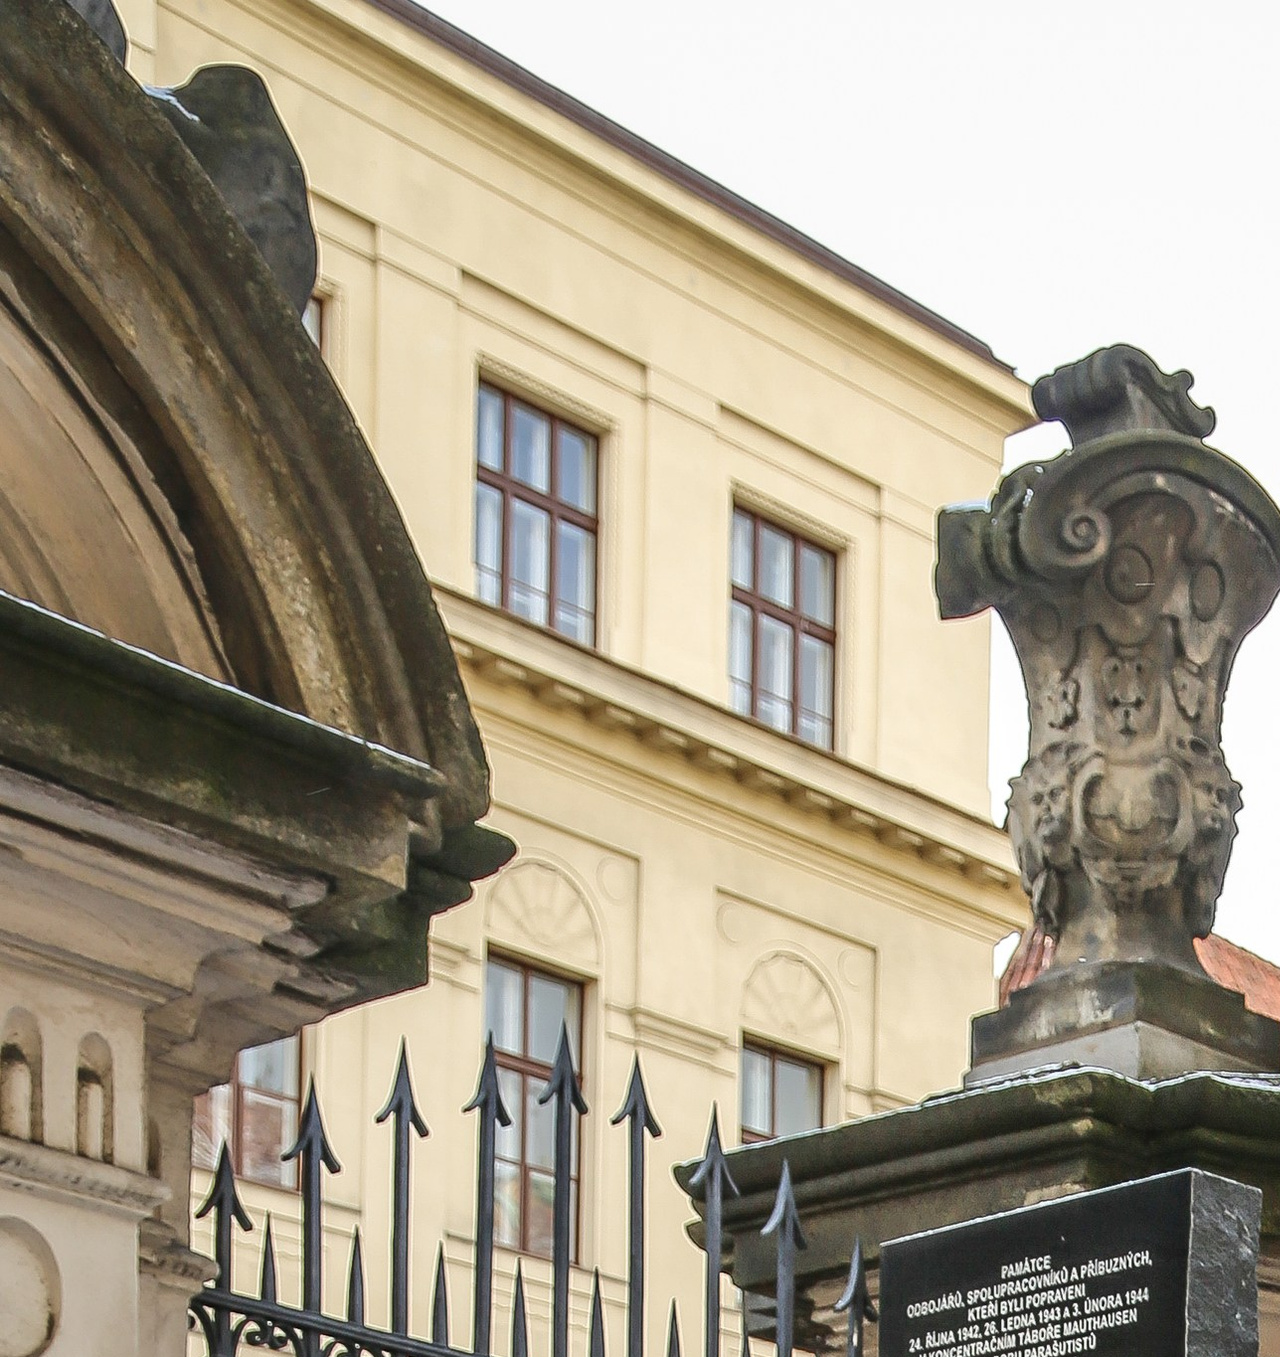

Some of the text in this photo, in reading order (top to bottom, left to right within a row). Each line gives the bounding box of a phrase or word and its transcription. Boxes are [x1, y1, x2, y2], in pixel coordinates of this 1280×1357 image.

[966, 1267, 1069, 1305] SPOLUPRACOVNÍKŮ
[1069, 1267, 1079, 1282] A
[1080, 1249, 1153, 1279] PŘÍBUZNÝCH,
[1000, 1254, 1051, 1279] PAMÁTCE
[908, 1337, 924, 1353] 24.
[924, 1330, 956, 1349] ŘÍJNA
[984, 1321, 998, 1336] 26.
[1001, 1312, 1036, 1332] LEDNA
[1038, 1306, 1061, 1323] 1943
[1062, 1306, 1070, 1318] A
[1072, 1302, 1081, 1317] 3.
[1084, 1292, 1123, 1314] ÚNORA
[1124, 1286, 1149, 1305] 1944
[967, 1282, 1086, 1322] KTEŘÍ BYLI POPRAVENI
[1017, 1323, 1061, 1345] TÁBOŘE
[1063, 1307, 1138, 1336] MAUTHAUSEN
